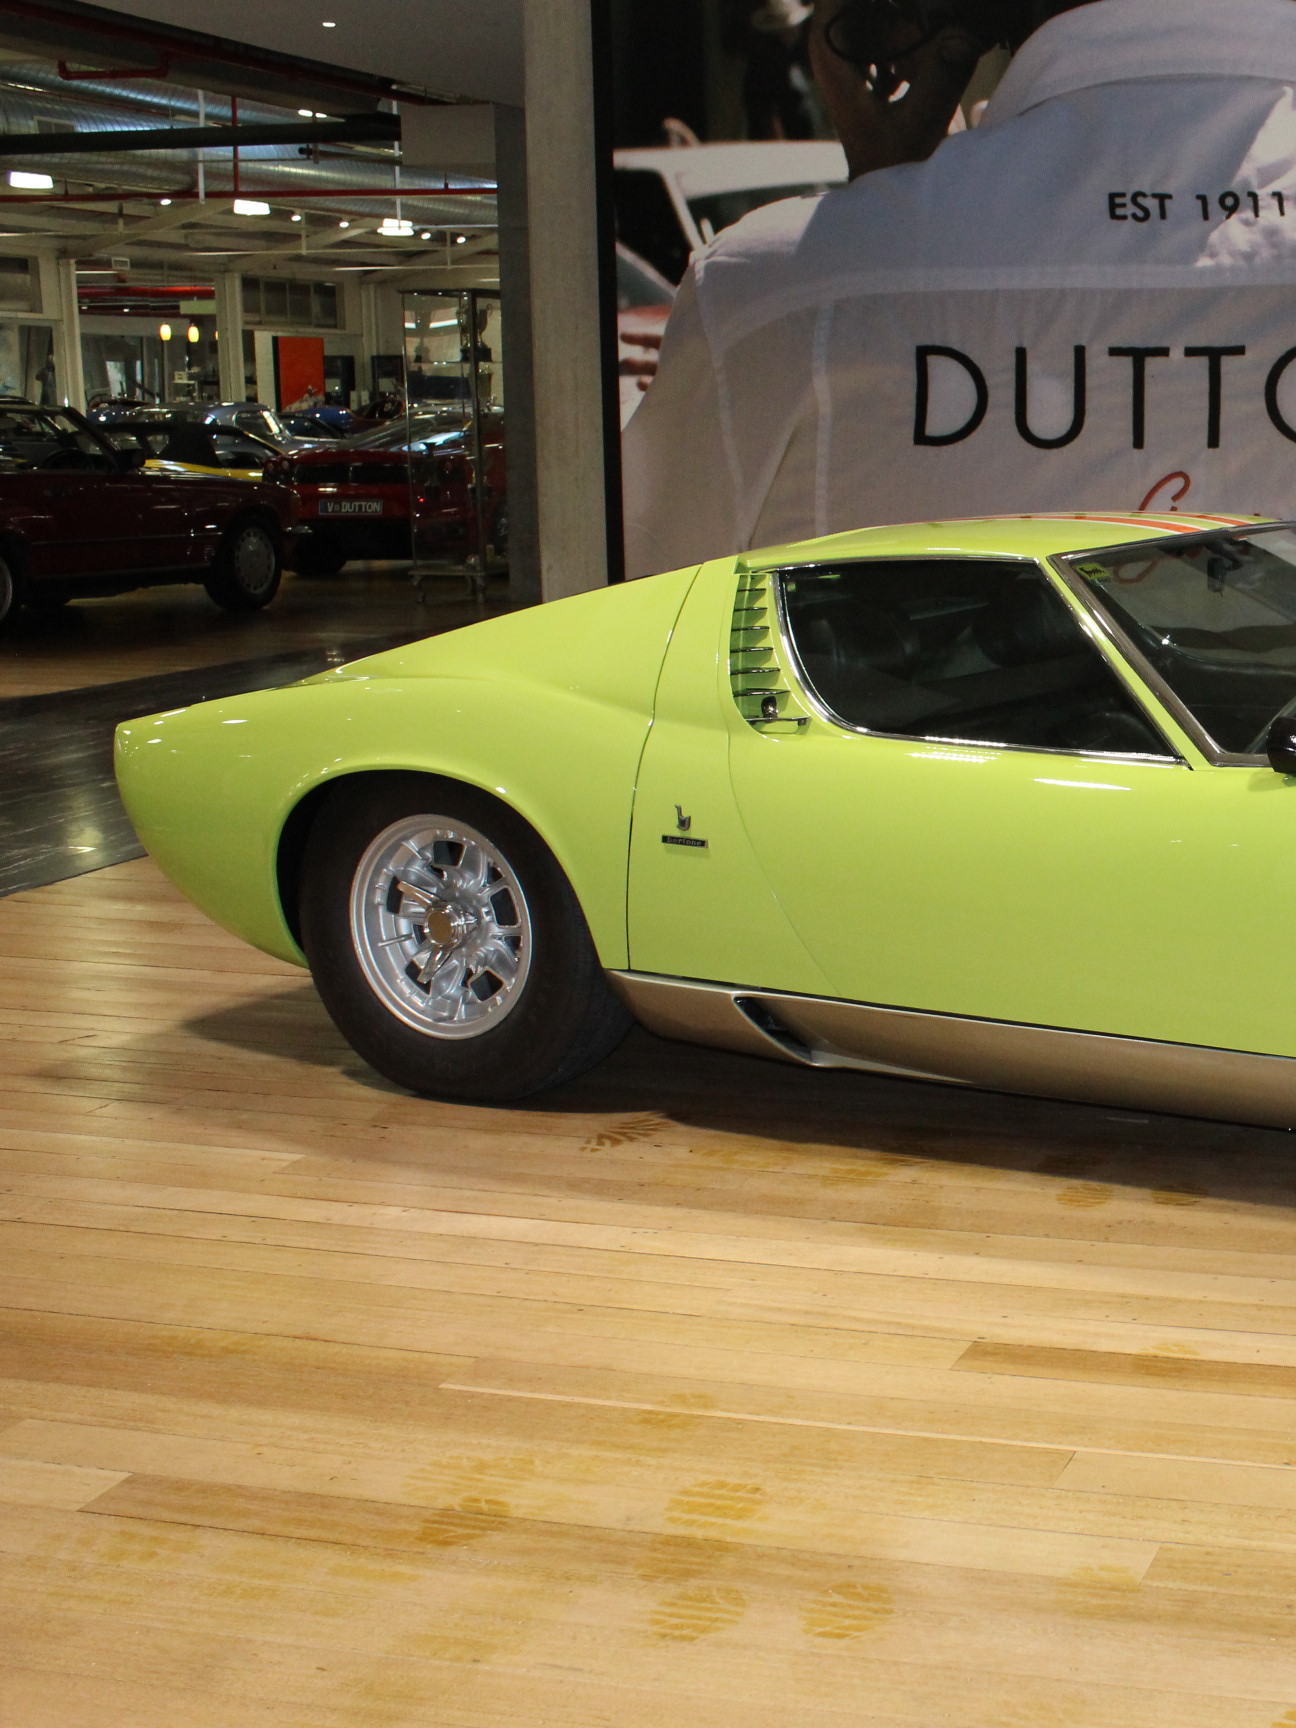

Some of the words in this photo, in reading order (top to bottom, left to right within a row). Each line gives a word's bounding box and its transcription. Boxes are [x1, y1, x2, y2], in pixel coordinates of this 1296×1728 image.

[1107, 190, 1173, 223] EST
[1195, 190, 1285, 222] 1911
[341, 501, 381, 513] DUTTON
